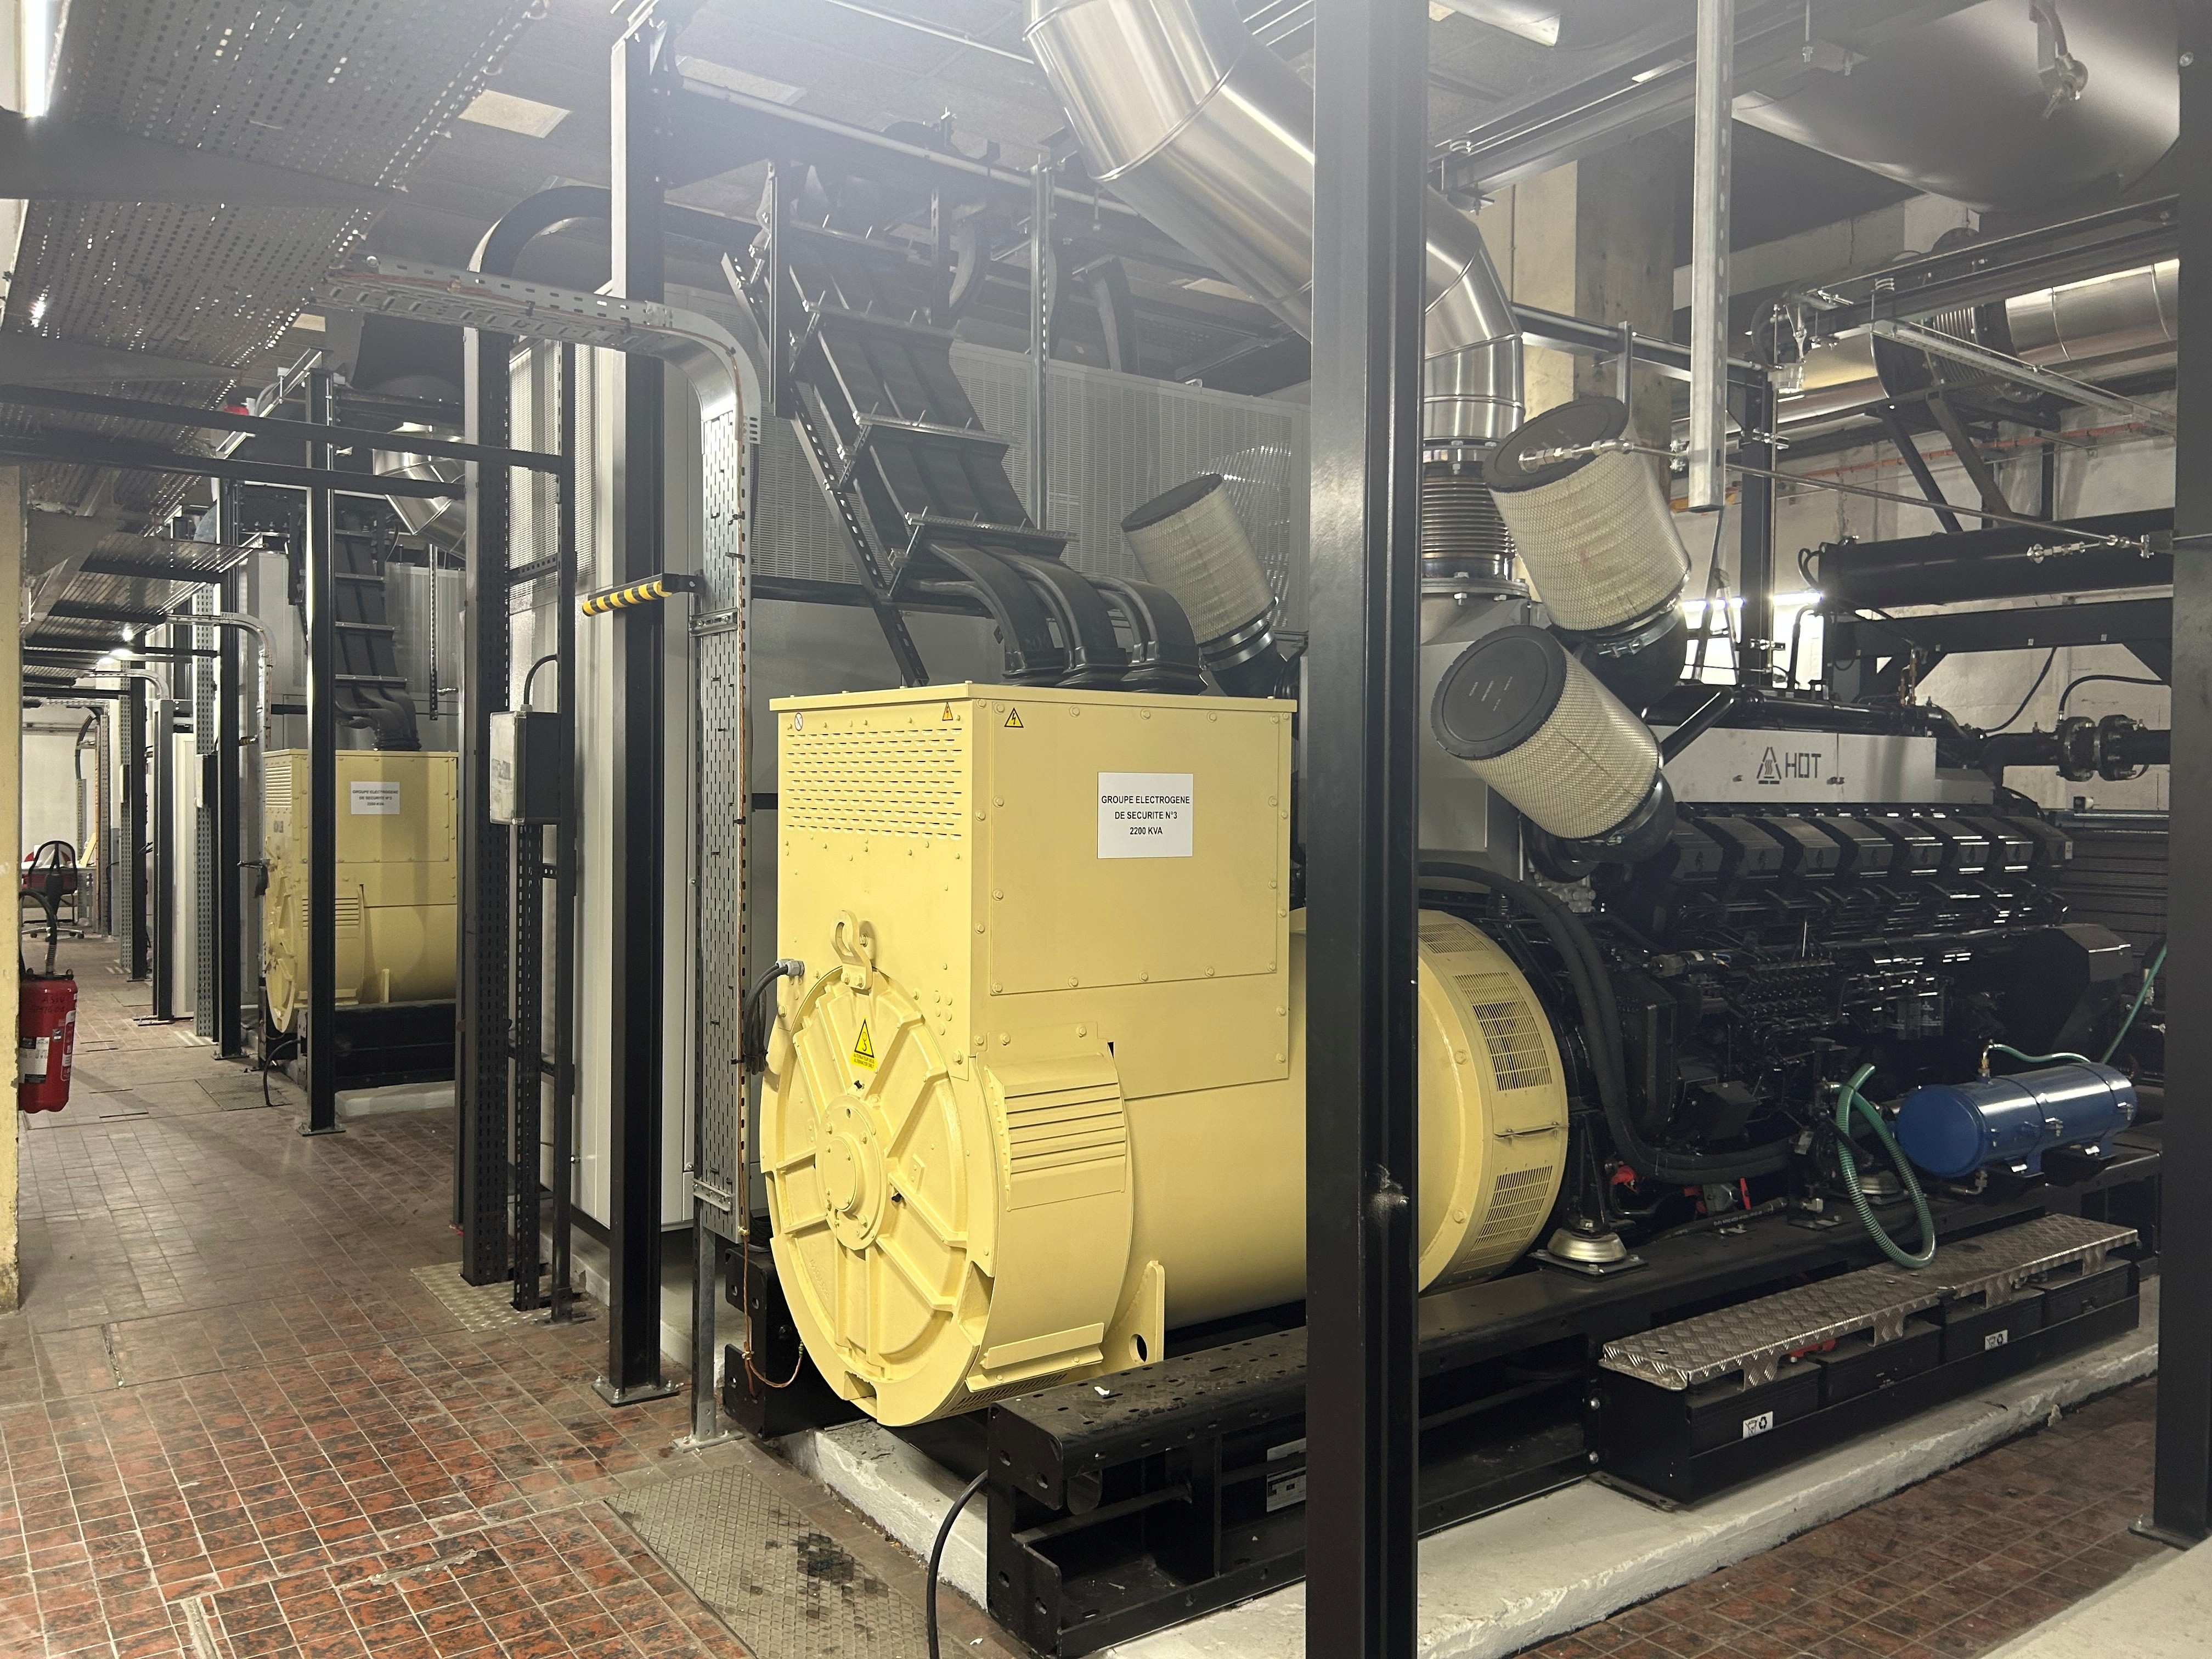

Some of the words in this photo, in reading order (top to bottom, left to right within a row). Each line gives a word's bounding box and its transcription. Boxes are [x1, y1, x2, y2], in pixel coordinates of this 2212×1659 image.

[1785, 752, 1822, 779] HOT
[1101, 795, 1134, 804] GROUPE
[1135, 795, 1190, 804] ELECTROGENE
[1115, 811, 1125, 820] DE
[1126, 811, 1164, 820] SECURITE
[1165, 811, 1178, 820] N°3
[1130, 827, 1146, 835] 2200
[1148, 827, 1163, 835] KVA
